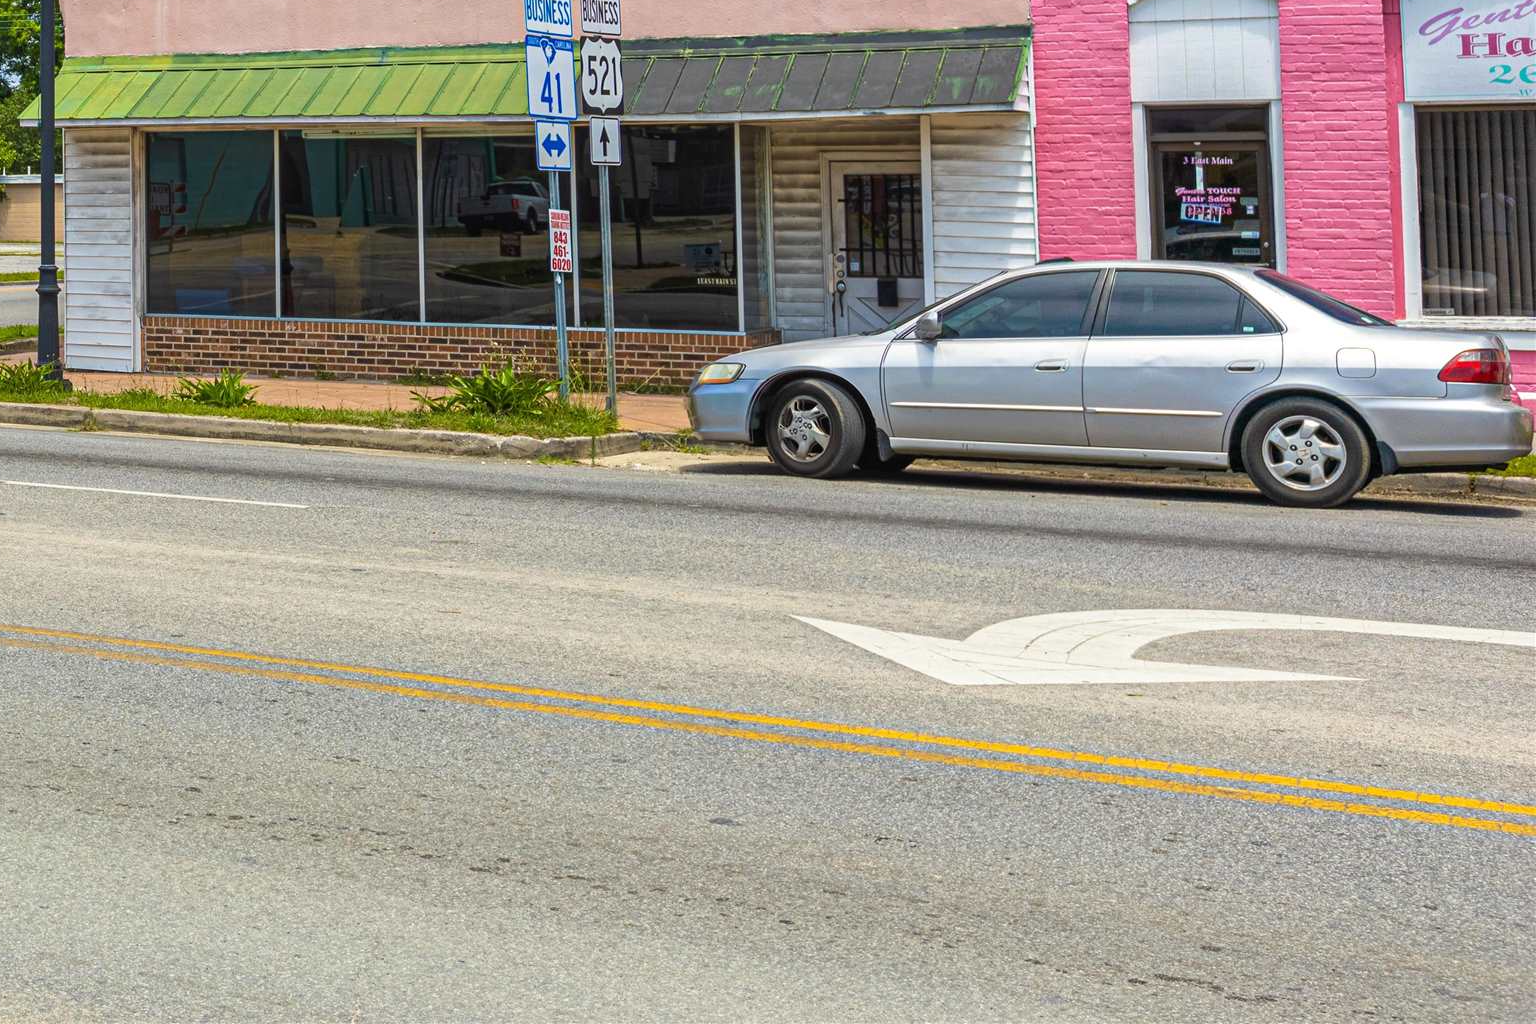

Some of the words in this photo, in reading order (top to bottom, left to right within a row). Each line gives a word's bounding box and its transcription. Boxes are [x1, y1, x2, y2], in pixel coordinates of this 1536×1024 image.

[589, 55, 618, 97] 521
[540, 71, 563, 114] 41
[1191, 156, 1209, 165] East
[1211, 156, 1233, 165] Main
[1208, 195, 1236, 203] Salon
[554, 231, 567, 245] 843
[554, 245, 569, 258] 461-
[552, 258, 571, 272] 6020
